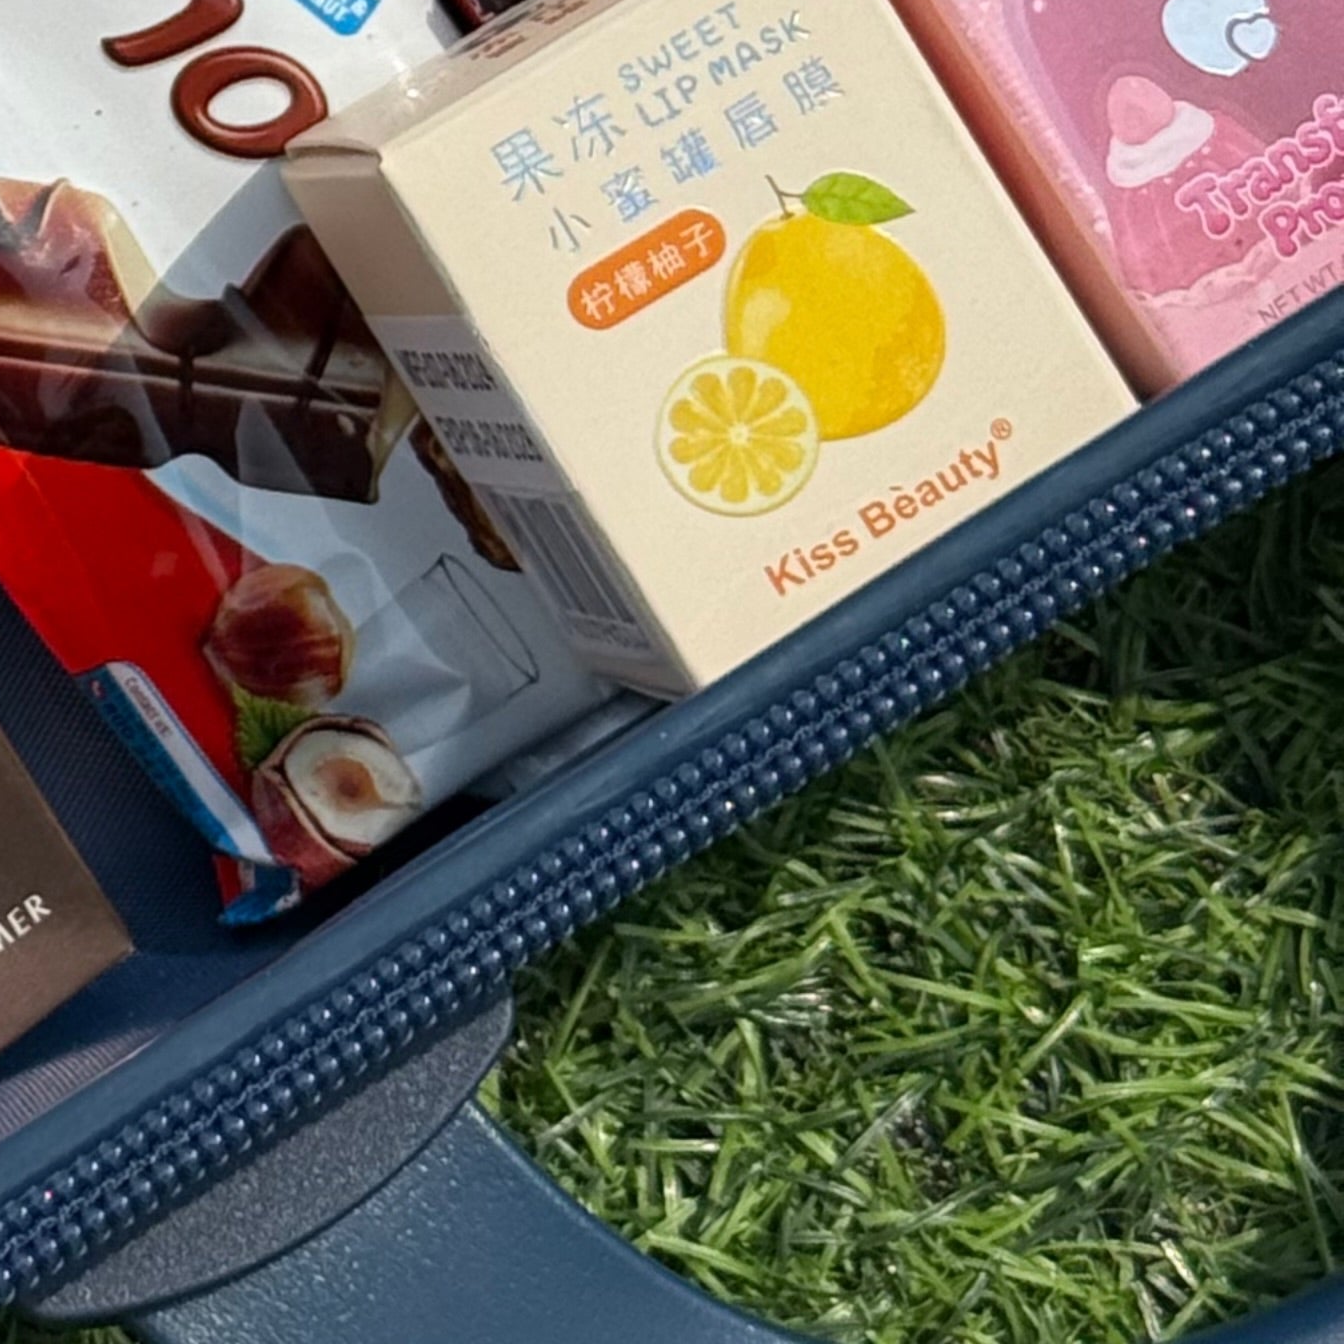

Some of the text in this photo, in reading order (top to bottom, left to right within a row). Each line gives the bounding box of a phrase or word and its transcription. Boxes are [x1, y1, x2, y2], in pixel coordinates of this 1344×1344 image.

[618, 2, 742, 93] SWEET
[634, 74, 698, 128] LIP
[707, 10, 811, 87] MASK
[490, 92, 628, 202] 果冻
[548, 54, 846, 254] 小蜜罐唇膜
[579, 221, 714, 322] 柠檬柚子
[764, 523, 859, 597] Kiss
